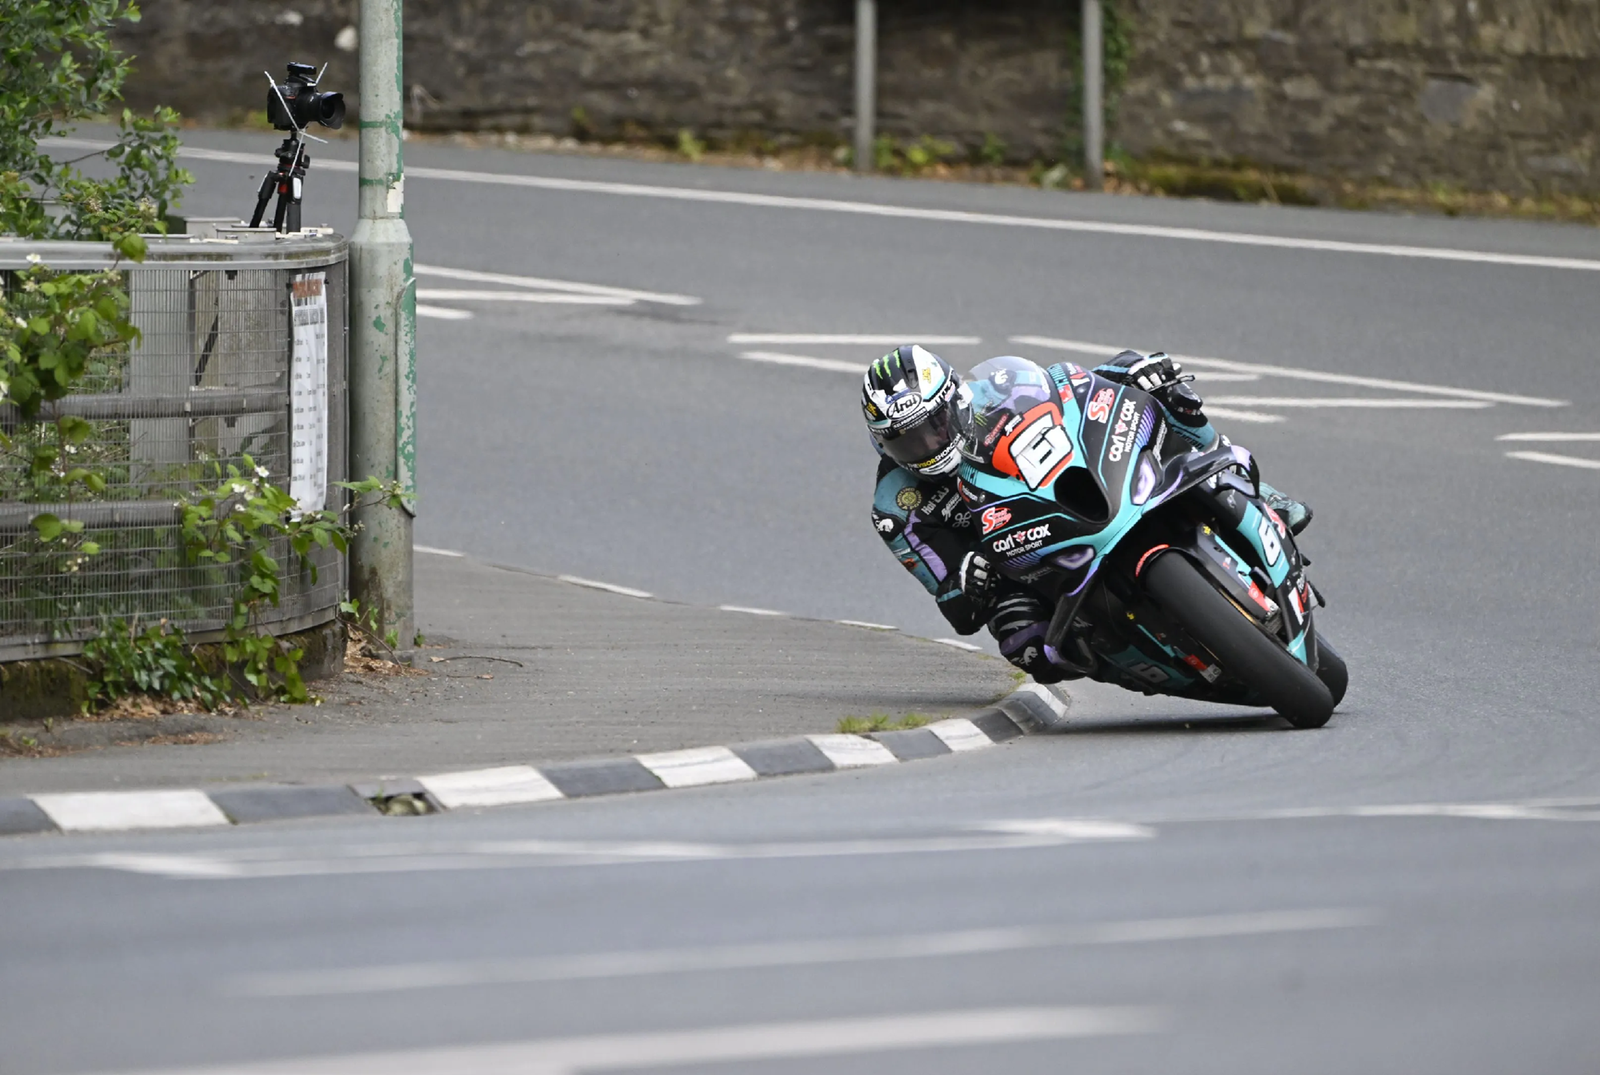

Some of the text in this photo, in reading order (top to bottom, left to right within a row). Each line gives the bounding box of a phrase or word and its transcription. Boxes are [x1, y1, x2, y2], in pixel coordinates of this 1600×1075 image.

[893, 394, 918, 414] Arai
[1010, 413, 1072, 489] 6
[1006, 540, 1043, 557] MOTOR SPORT
[1259, 516, 1281, 566] 6
